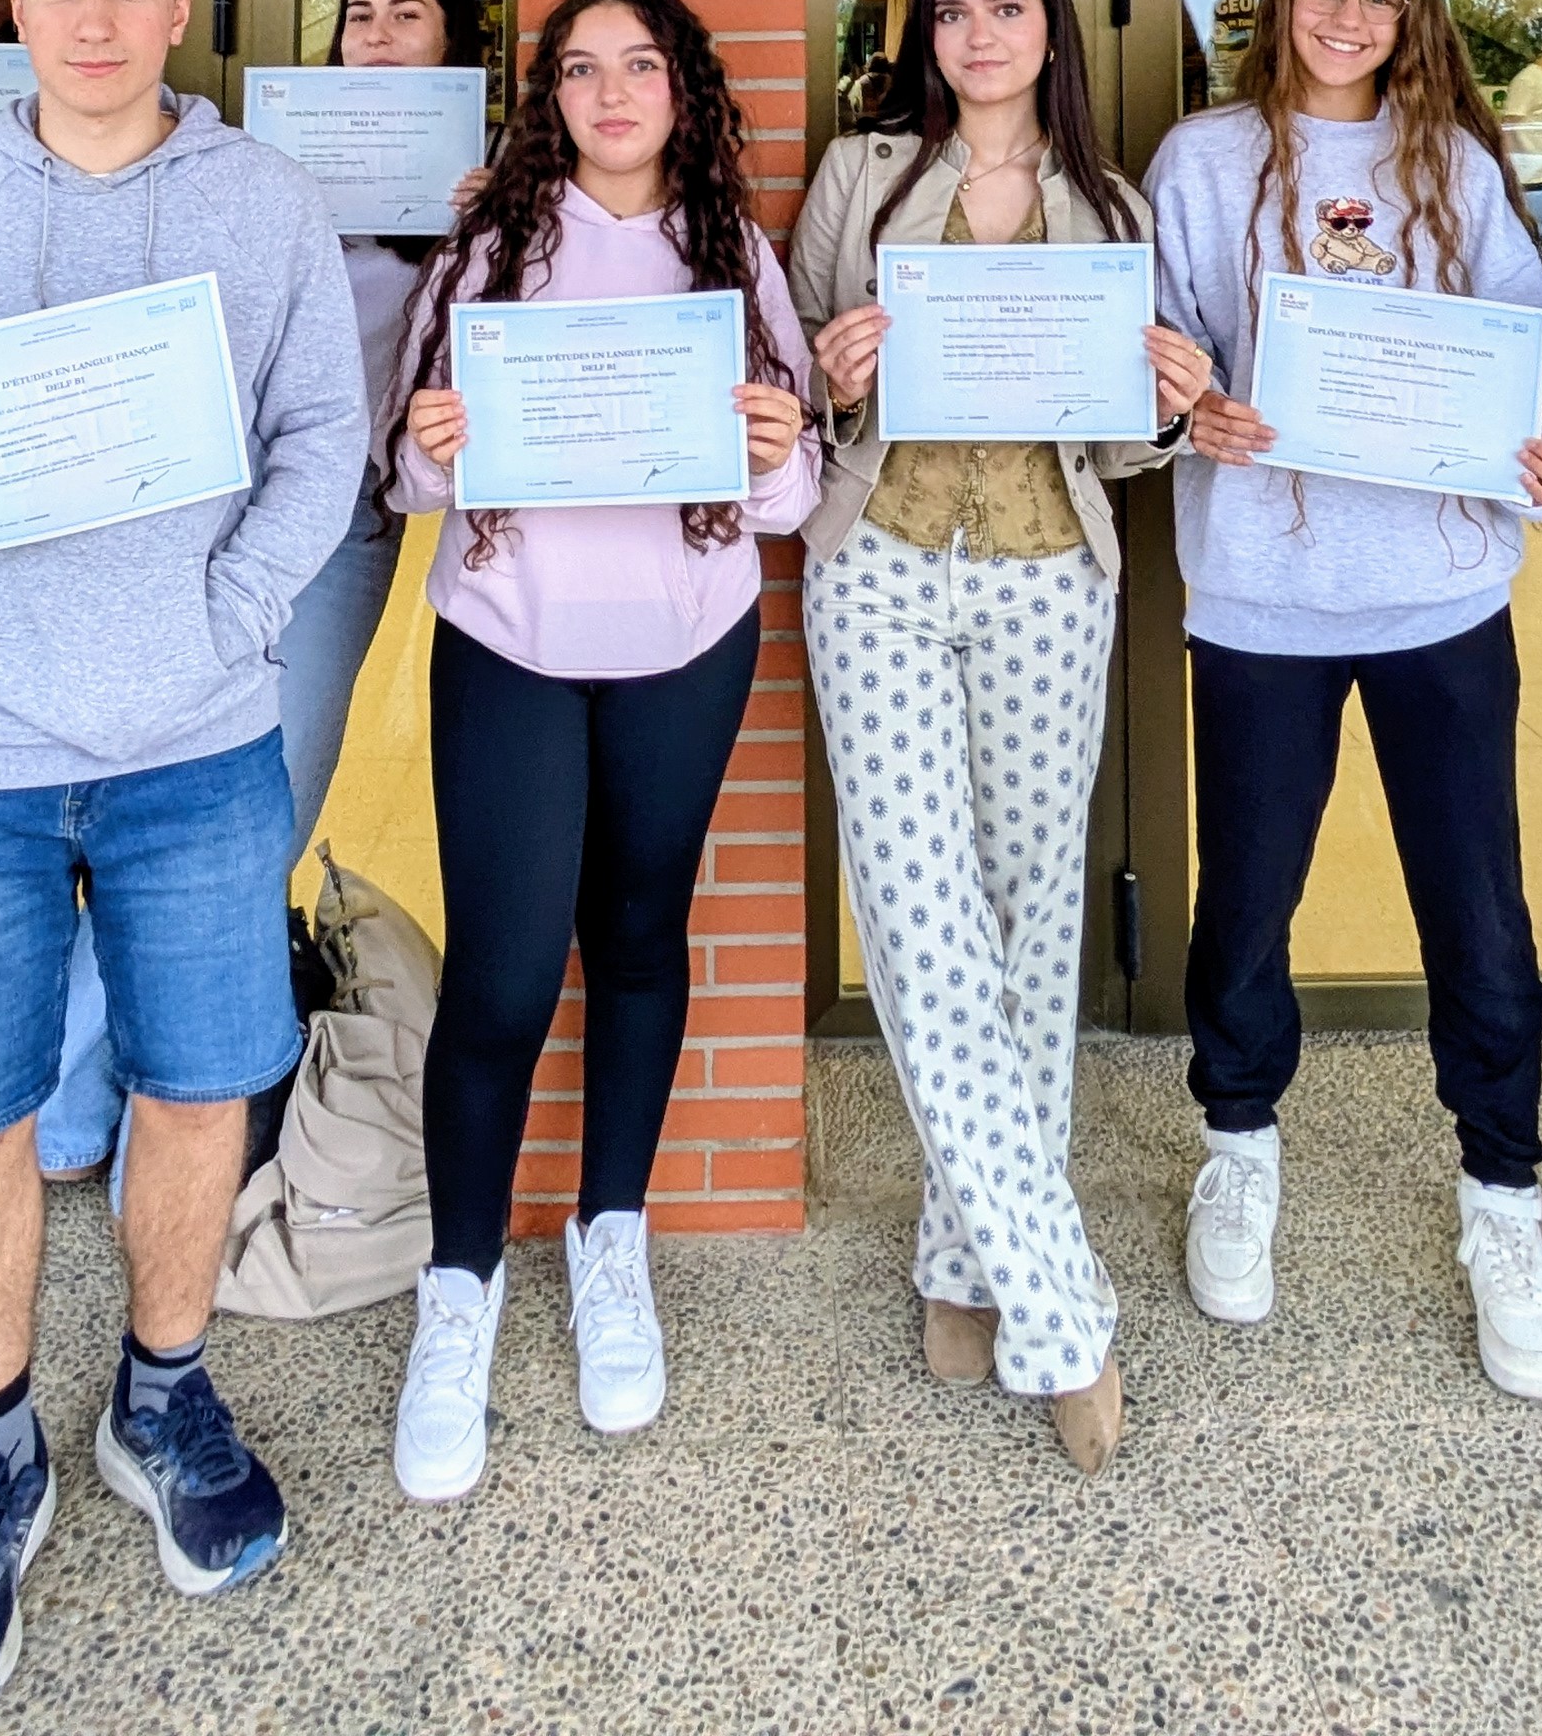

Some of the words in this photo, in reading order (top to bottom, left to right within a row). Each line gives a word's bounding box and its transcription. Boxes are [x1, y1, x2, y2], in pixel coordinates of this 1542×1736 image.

[1, 369, 53, 390] D'ÉTUDES
[55, 366, 71, 376] EN
[71, 354, 114, 372] LANGUE
[115, 341, 170, 361] FRANÇAISE
[45, 380, 73, 393] DELF
